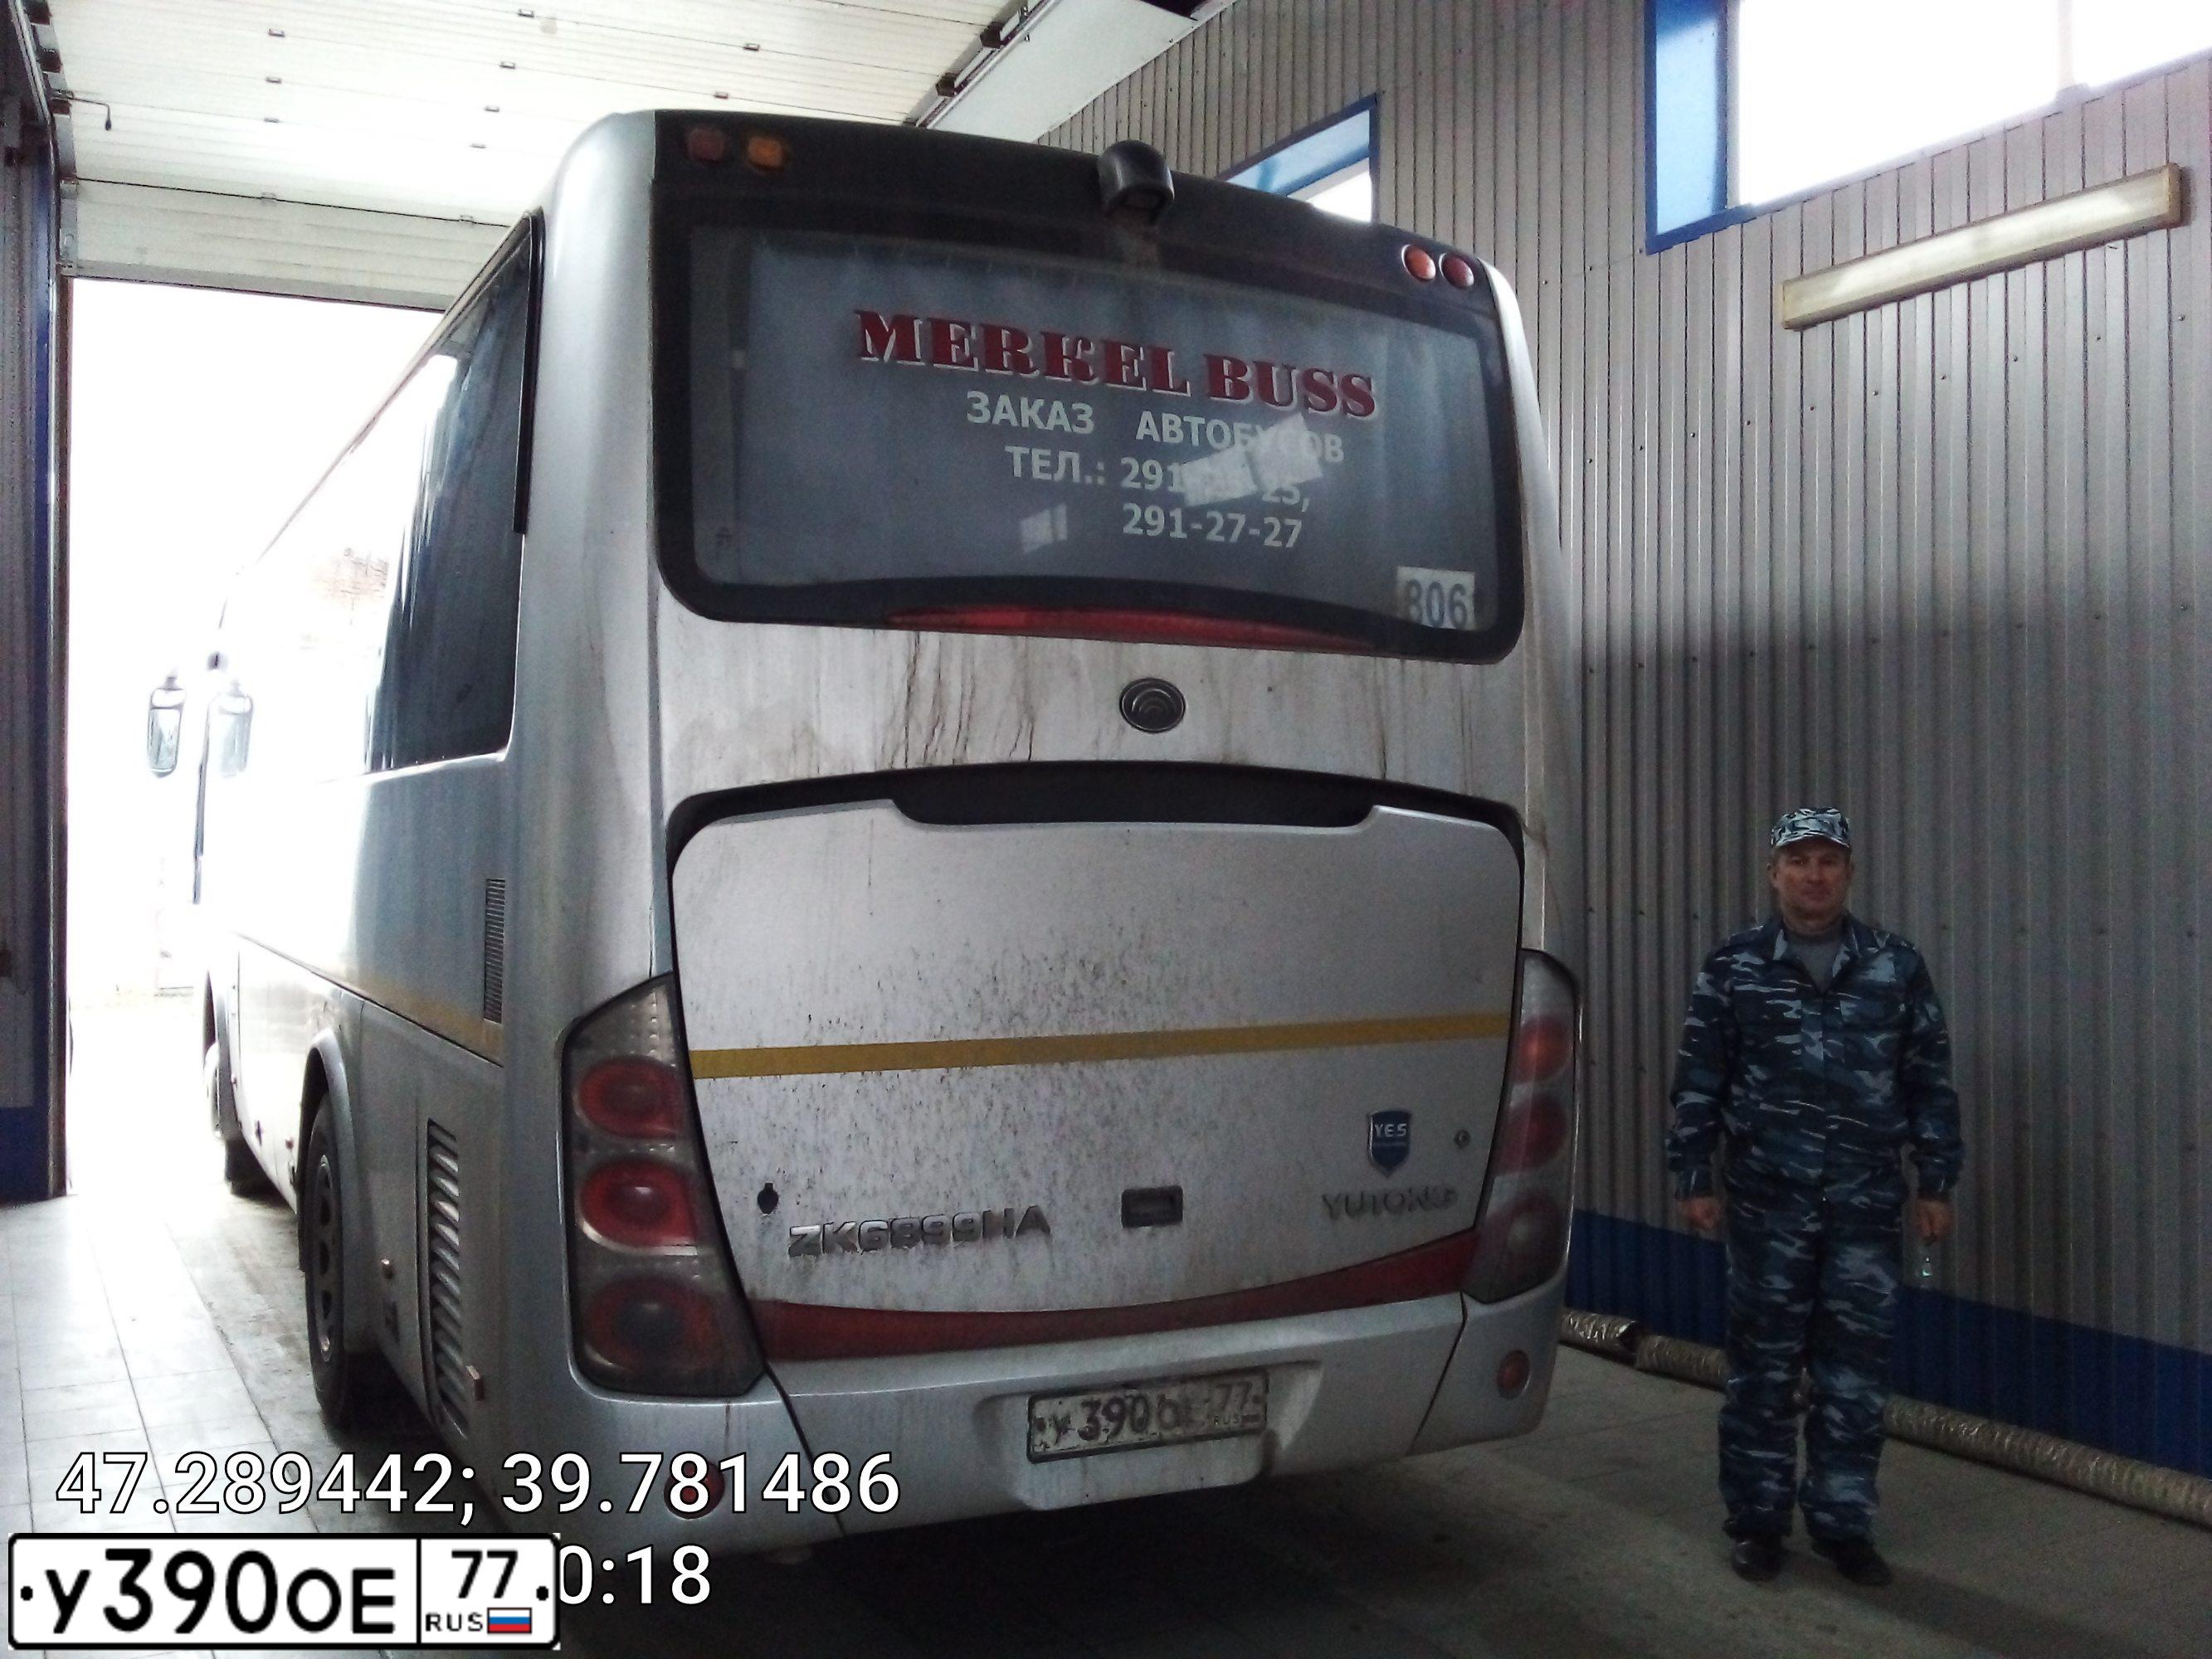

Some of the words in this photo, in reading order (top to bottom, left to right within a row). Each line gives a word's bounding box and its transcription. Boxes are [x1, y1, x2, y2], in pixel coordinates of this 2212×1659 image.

[854, 310, 1190, 397] MERKEL
[1203, 353, 1379, 419] BUSS
[966, 390, 1094, 435] ЗАКАЗ
[1006, 445, 1106, 484] ТЕЛ.:
[1123, 502, 1303, 548] 291-27-27
[1374, 1123, 1408, 1138] YES
